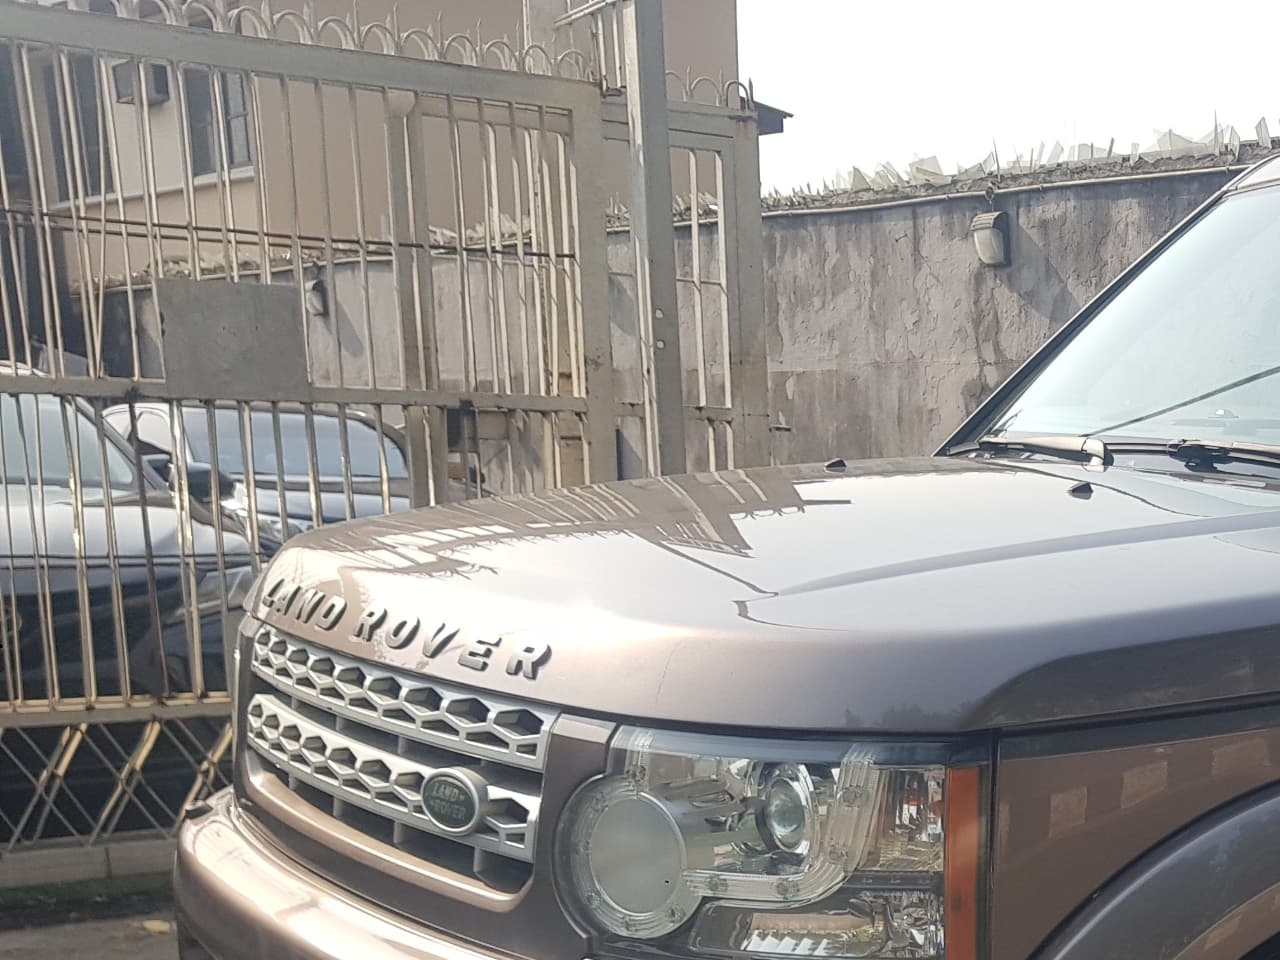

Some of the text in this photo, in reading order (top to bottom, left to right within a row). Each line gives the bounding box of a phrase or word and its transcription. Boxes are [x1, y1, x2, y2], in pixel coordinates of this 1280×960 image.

[262, 578, 552, 680] LAND ROVER
[432, 782, 460, 802] LAND
